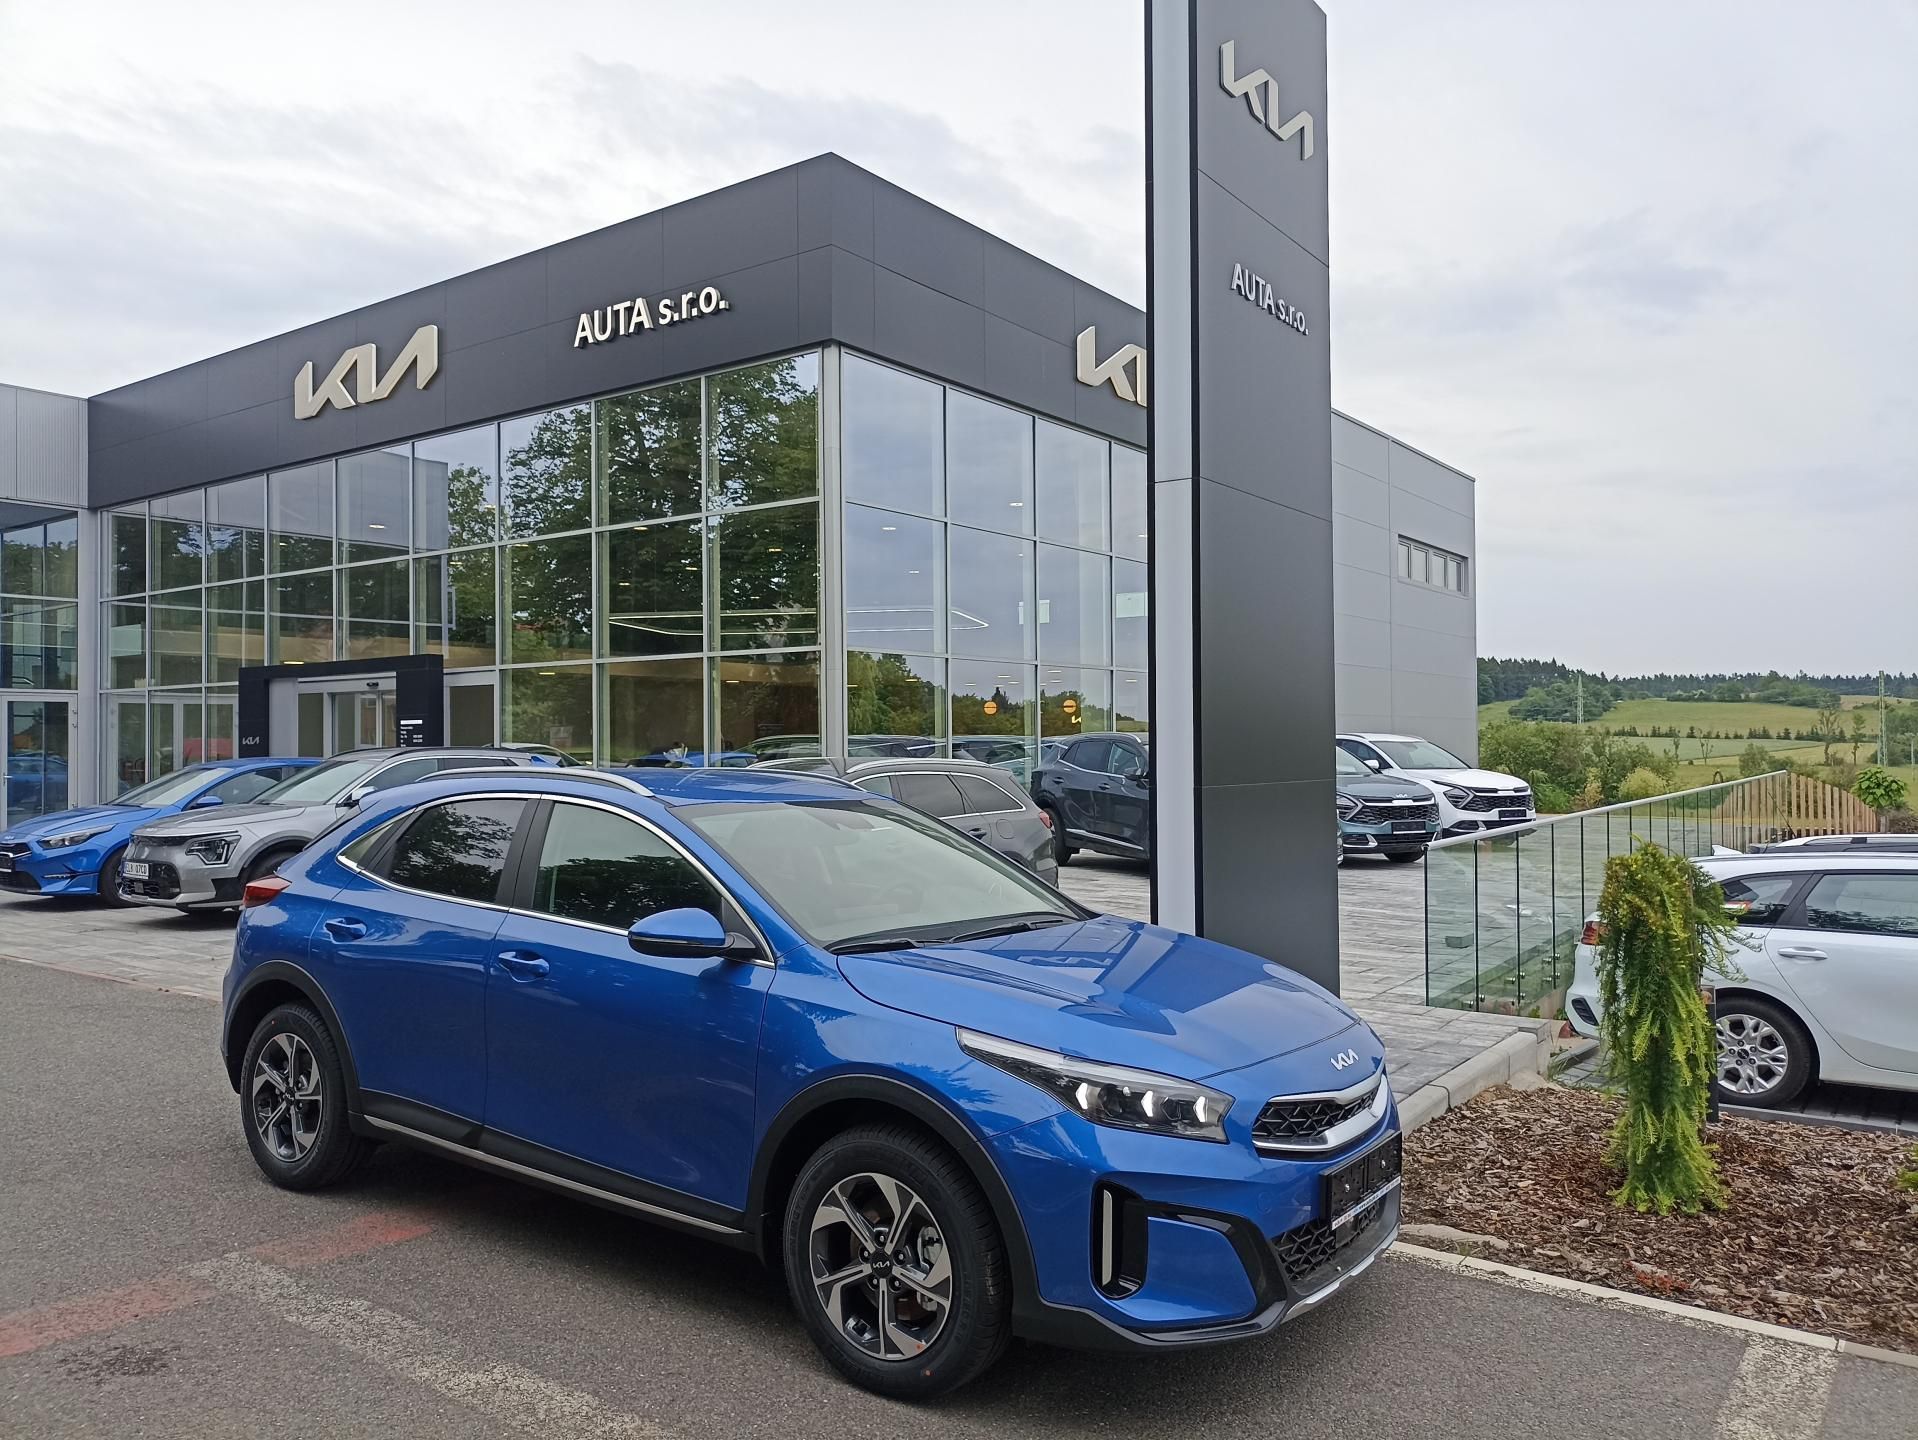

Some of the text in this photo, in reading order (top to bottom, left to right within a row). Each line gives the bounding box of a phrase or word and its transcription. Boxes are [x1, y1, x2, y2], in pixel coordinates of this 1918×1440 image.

[1220, 40, 1313, 160] KIA
[573, 286, 729, 348] AUTA s.r.o.
[1231, 263, 1309, 335] AUTA s.r.o.
[294, 324, 440, 420] KIA
[1076, 325, 1147, 407] KI
[242, 736, 260, 745] KIA
[1330, 1048, 1359, 1071] KIA
[872, 1260, 890, 1268] KIA
